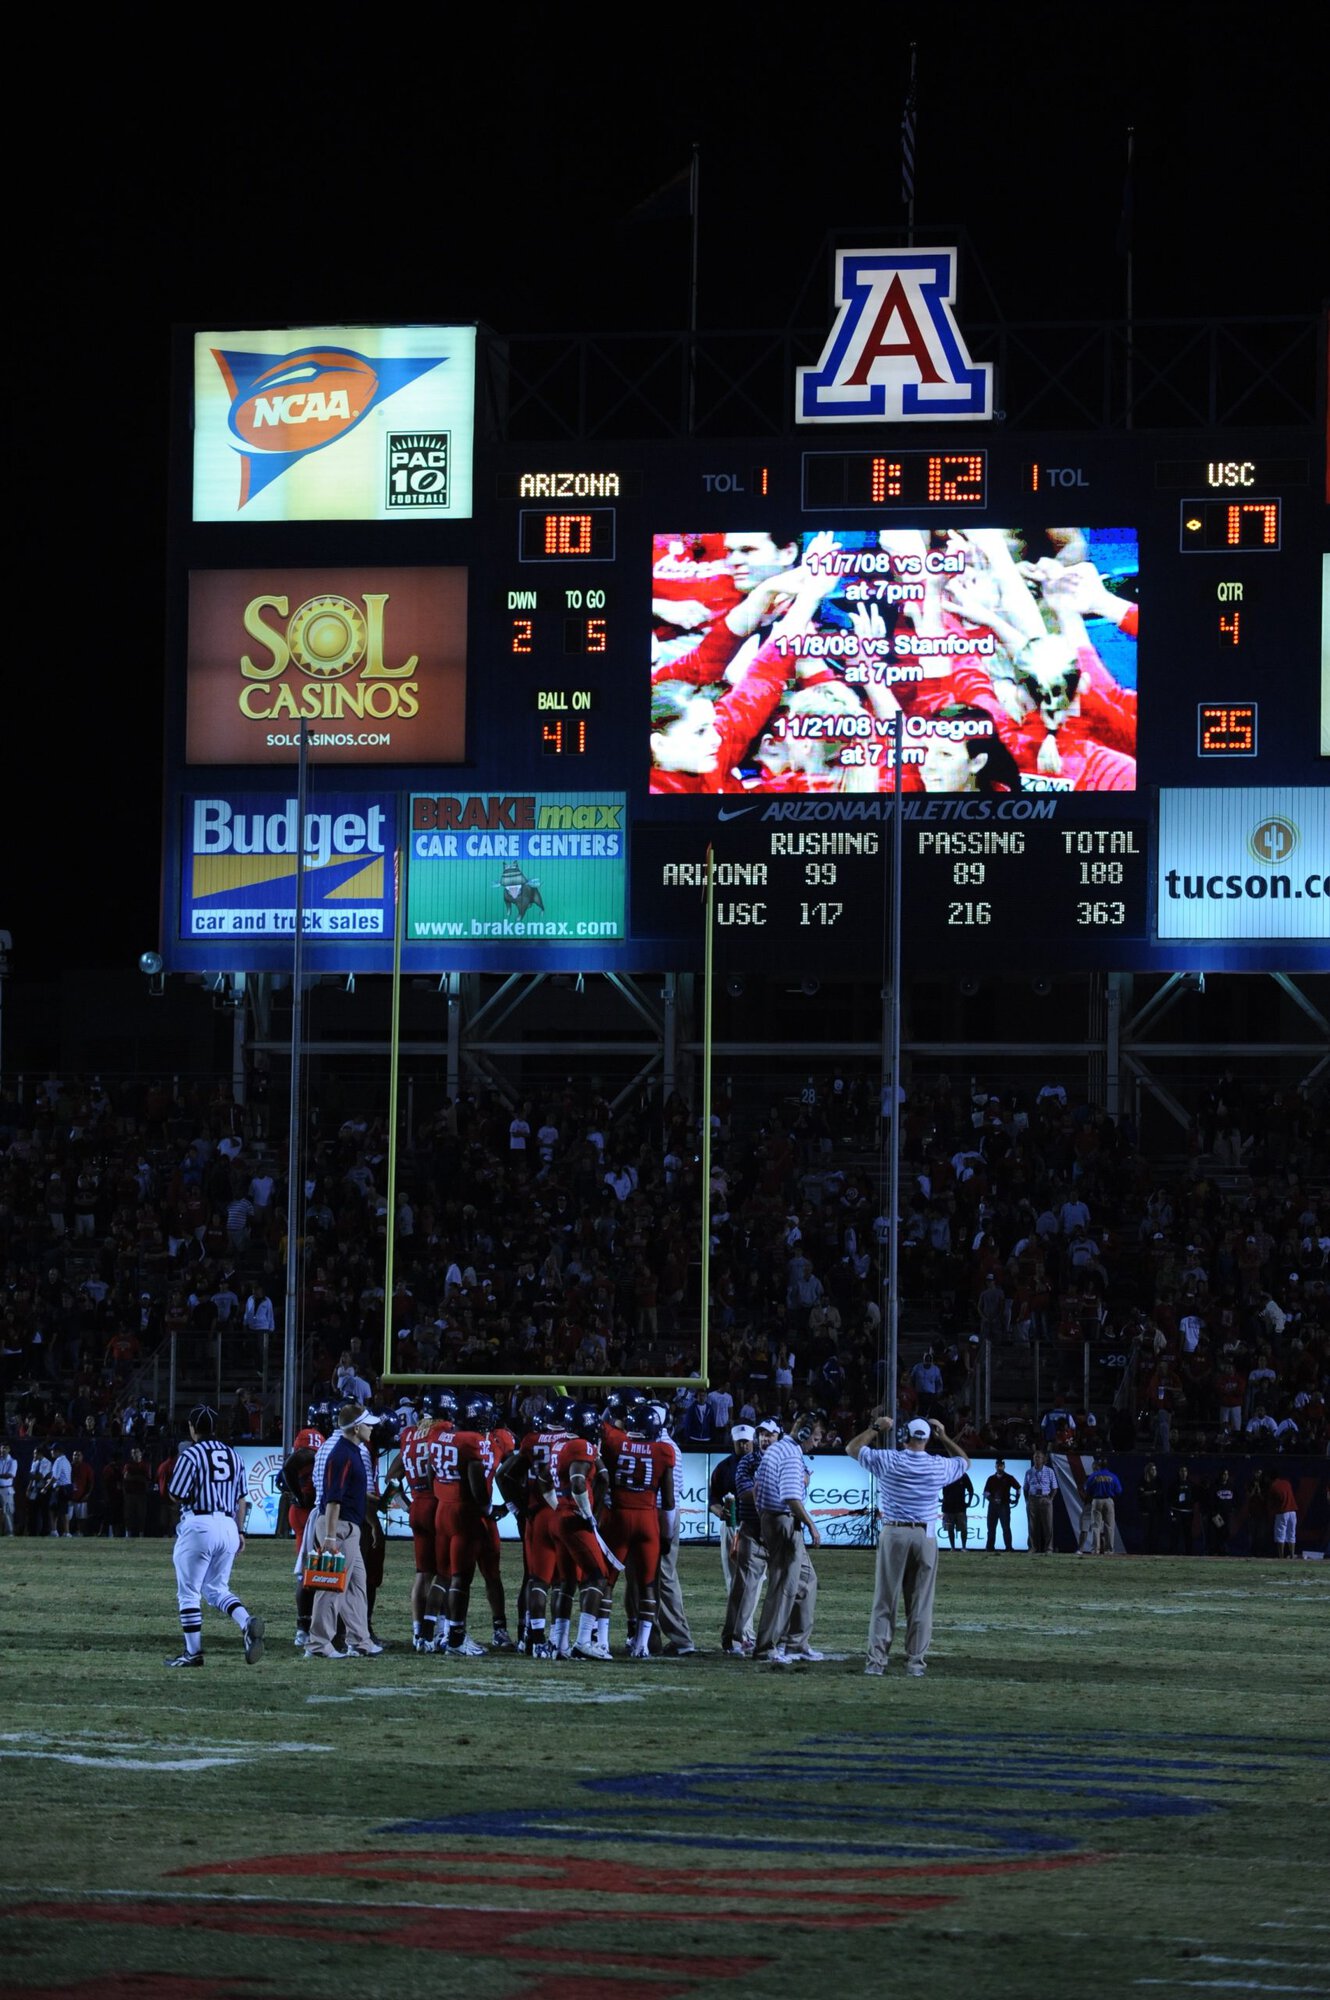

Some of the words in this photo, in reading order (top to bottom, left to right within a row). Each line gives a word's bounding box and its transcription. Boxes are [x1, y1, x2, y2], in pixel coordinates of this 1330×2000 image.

[796, 247, 993, 424] A
[253, 389, 350, 428] NCAA
[391, 451, 446, 468] PAC
[391, 469, 446, 493] 10
[520, 473, 619, 497] ARIZONA
[702, 473, 745, 492] TOL
[872, 457, 983, 502] 1:12
[1046, 468, 1089, 487] TOL
[1208, 462, 1255, 487] USC
[391, 493, 445, 504] FOOTBALL
[545, 516, 591, 553] 10
[1227, 505, 1277, 545] 17
[806, 553, 890, 574] 11/7/08
[894, 556, 922, 573] vs
[926, 552, 965, 573] Cal
[508, 591, 537, 609] DWN
[566, 590, 582, 609] TO
[586, 590, 605, 609] GO
[845, 581, 869, 600] at
[874, 582, 924, 603] 7pm
[1217, 582, 1243, 602] QTR
[240, 593, 419, 680] SOL
[512, 620, 532, 653] 2
[587, 619, 606, 651] 5
[1220, 612, 1239, 645] 4
[775, 635, 859, 656] 11/8/08
[863, 638, 890, 655] vs
[895, 634, 994, 655] Stanford
[845, 664, 869, 682] at
[873, 663, 923, 686] 7pm
[238, 682, 419, 719] CASINOS
[537, 692, 568, 710] BALL
[572, 691, 591, 709] ON
[543, 721, 586, 753] 41
[773, 717, 871, 737] 11/21/08
[906, 716, 993, 740] Oregon
[1203, 709, 1252, 749] 25
[840, 746, 865, 765] at
[412, 797, 536, 830] BRAKE
[537, 805, 625, 829] max
[761, 800, 1057, 821] ARIZONAATHLETICS.COM
[193, 799, 386, 868] Budget
[771, 833, 878, 854] RUSHING
[919, 832, 1025, 854] PASSING
[1061, 831, 1140, 853] TOTAL
[415, 835, 458, 857] CAR
[465, 834, 520, 857] CARE
[528, 834, 619, 856] CENTERS
[663, 863, 768, 885] ARIZONA
[805, 863, 837, 885] 99
[953, 862, 986, 885] 89
[1079, 862, 1123, 884] 188
[1165, 869, 1330, 899] tucson.c
[195, 916, 225, 929] car
[232, 912, 266, 929] and
[273, 912, 322, 929] truck
[329, 912, 380, 929] sales
[717, 903, 767, 925] USC
[948, 902, 992, 925] 216
[1077, 902, 1125, 925] 363
[307, 1433, 321, 1447] 15
[211, 1450, 231, 1481] S
[430, 1442, 461, 1480] 32
[615, 1454, 653, 1485] 21
